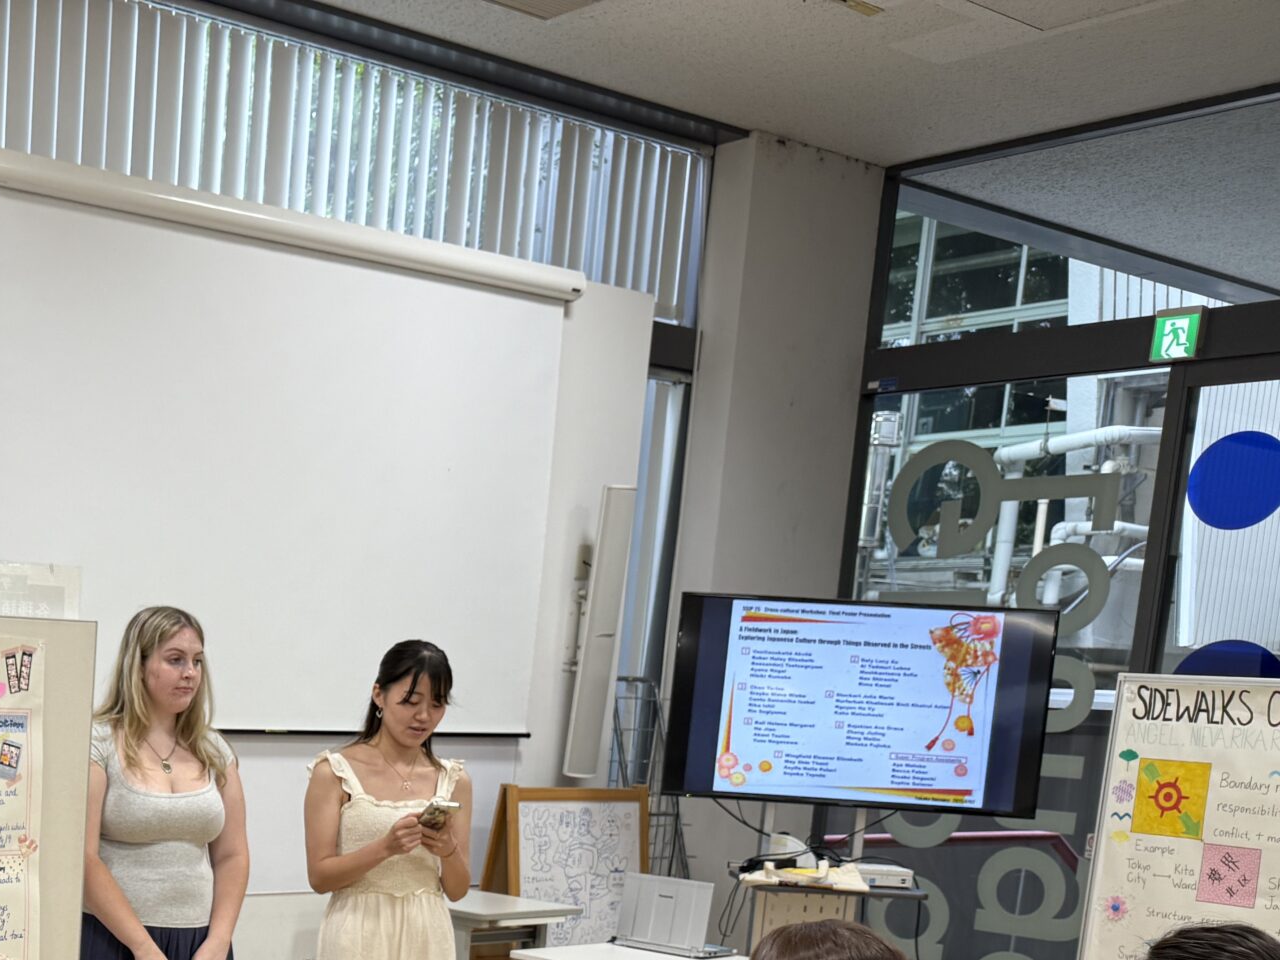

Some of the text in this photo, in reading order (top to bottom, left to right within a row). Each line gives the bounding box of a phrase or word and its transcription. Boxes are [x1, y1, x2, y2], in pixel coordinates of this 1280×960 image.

[744, 626, 772, 634] Fieldwork
[738, 634, 765, 642] Exploring
[767, 635, 794, 643] Japanese
[818, 638, 841, 646] through
[863, 640, 891, 648] Observed
[1132, 684, 1253, 726] SIDEWALKS
[1220, 771, 1270, 795] Boundary
[4, 788, 18, 797] and
[1135, 838, 1176, 856] Example
[1126, 857, 1151, 871] Tokyo
[1174, 864, 1195, 877] Kita
[1126, 873, 1147, 889] City
[1172, 879, 1197, 891] Ward
